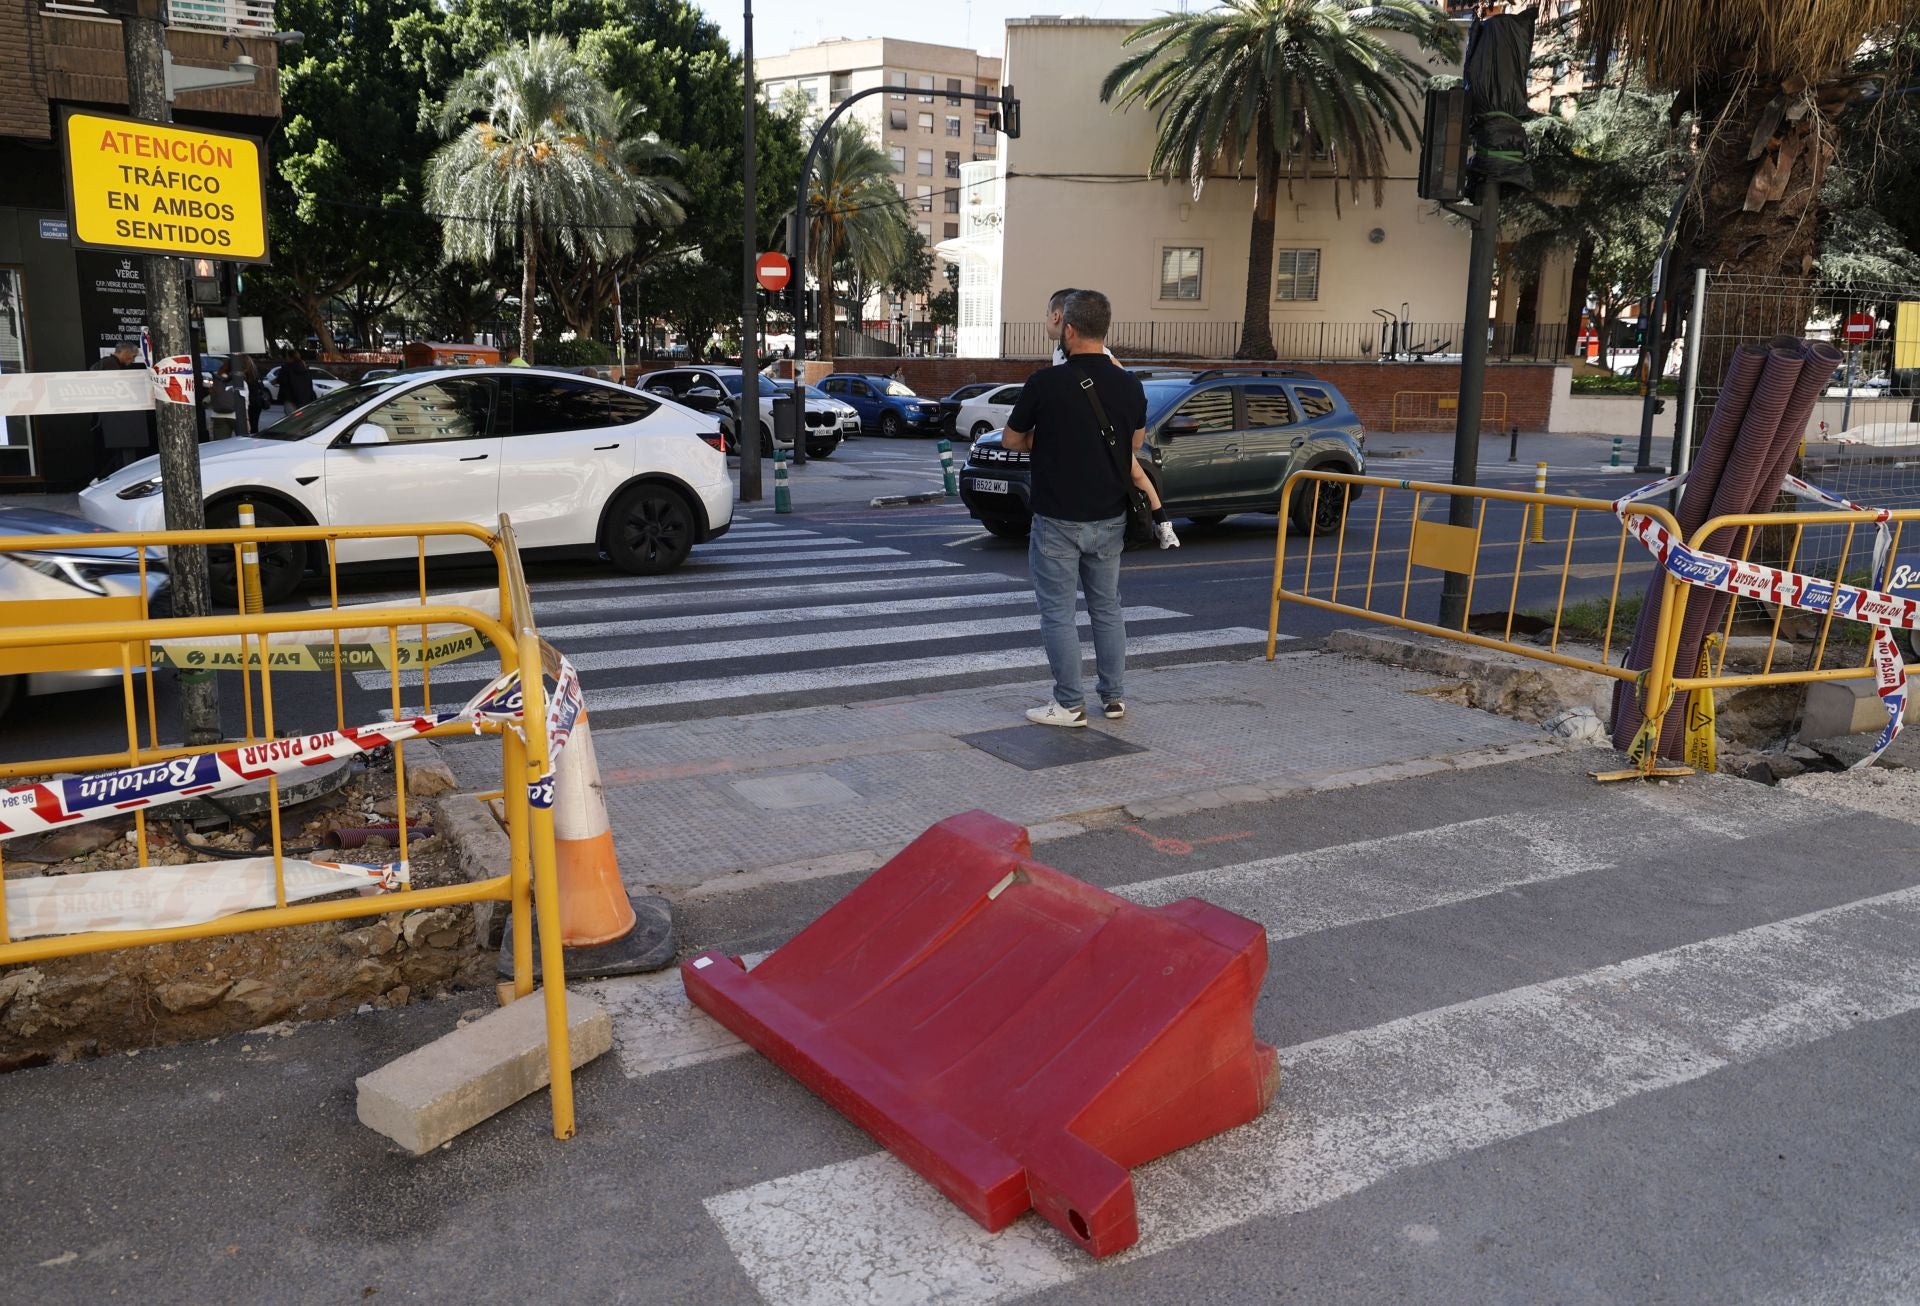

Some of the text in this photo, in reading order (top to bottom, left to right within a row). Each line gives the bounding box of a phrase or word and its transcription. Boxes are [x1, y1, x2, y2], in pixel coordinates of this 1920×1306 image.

[100, 130, 232, 168] ATENCIÓN
[118, 164, 220, 194] TRÁFICO
[107, 191, 235, 222] EN AMBOS
[116, 219, 231, 247] SENTIDOS
[115, 269, 139, 279] VERGE
[976, 480, 992, 491] 6522
[1674, 555, 1726, 582] Bertolin
[1735, 572, 1757, 586] PASAR
[1759, 579, 1771, 589] NO
[1807, 590, 1852, 610] Brtolin
[1863, 600, 1889, 615] PASAR
[1890, 605, 1903, 617] NO
[1878, 642, 1896, 685] NO PASAR
[244, 732, 335, 765] NO PASAR
[2, 755, 200, 809] Bertolin 96 384
